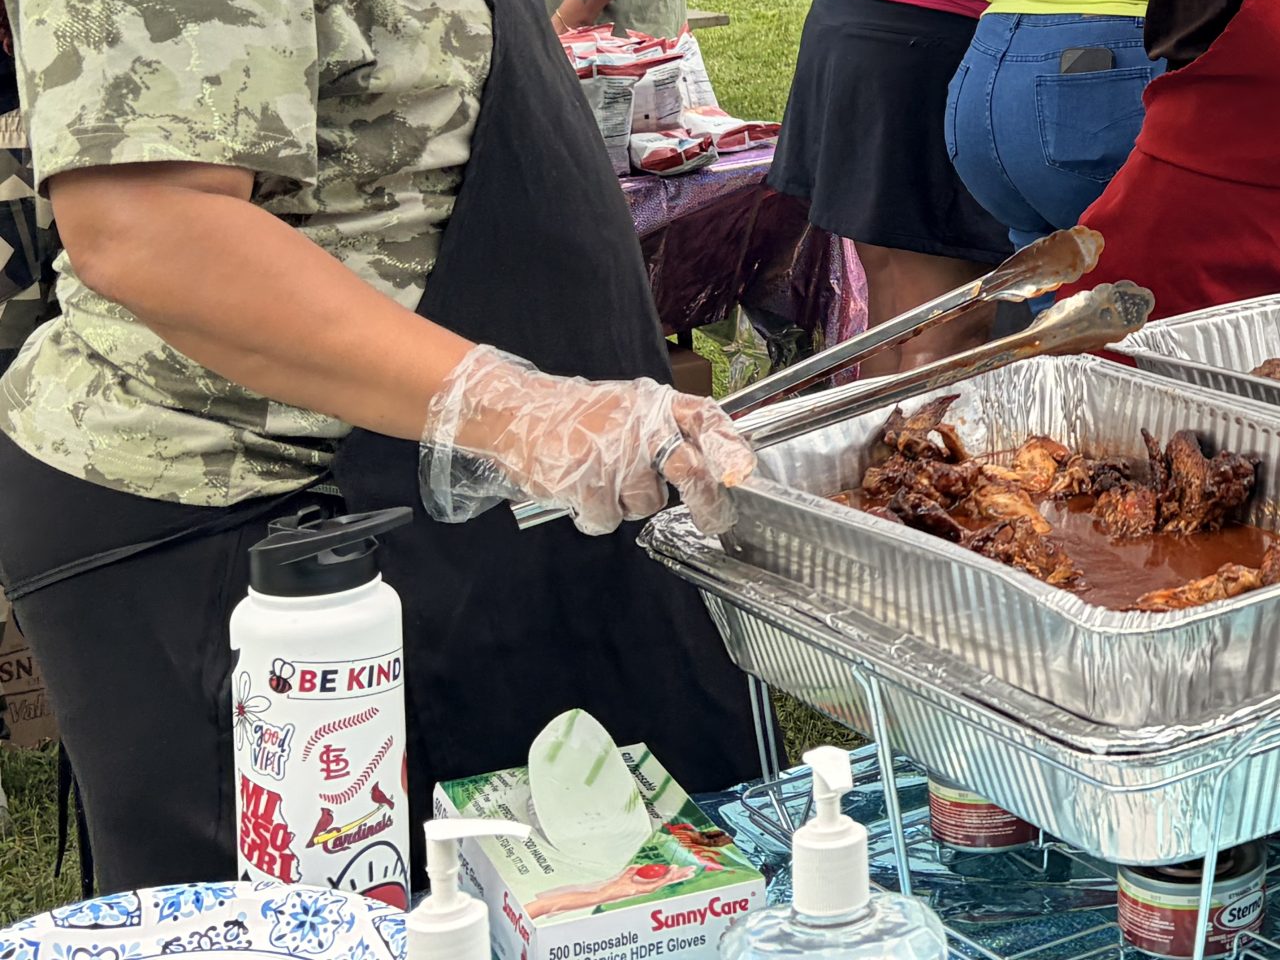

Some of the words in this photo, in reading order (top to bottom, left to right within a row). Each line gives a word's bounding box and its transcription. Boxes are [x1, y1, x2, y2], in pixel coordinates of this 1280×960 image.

[298, 669, 338, 693] BE
[347, 657, 401, 692] KIND
[254, 724, 290, 753] good
[253, 746, 285, 776] VIBES
[241, 773, 283, 827] MI
[322, 813, 394, 854] Cardinals
[650, 896, 749, 932] SunnyCare
[1228, 896, 1262, 923] Sterno
[549, 944, 570, 960] 500
[573, 931, 639, 957] Disposable
[631, 942, 664, 960] HDPE
[667, 934, 706, 952] Gloves
